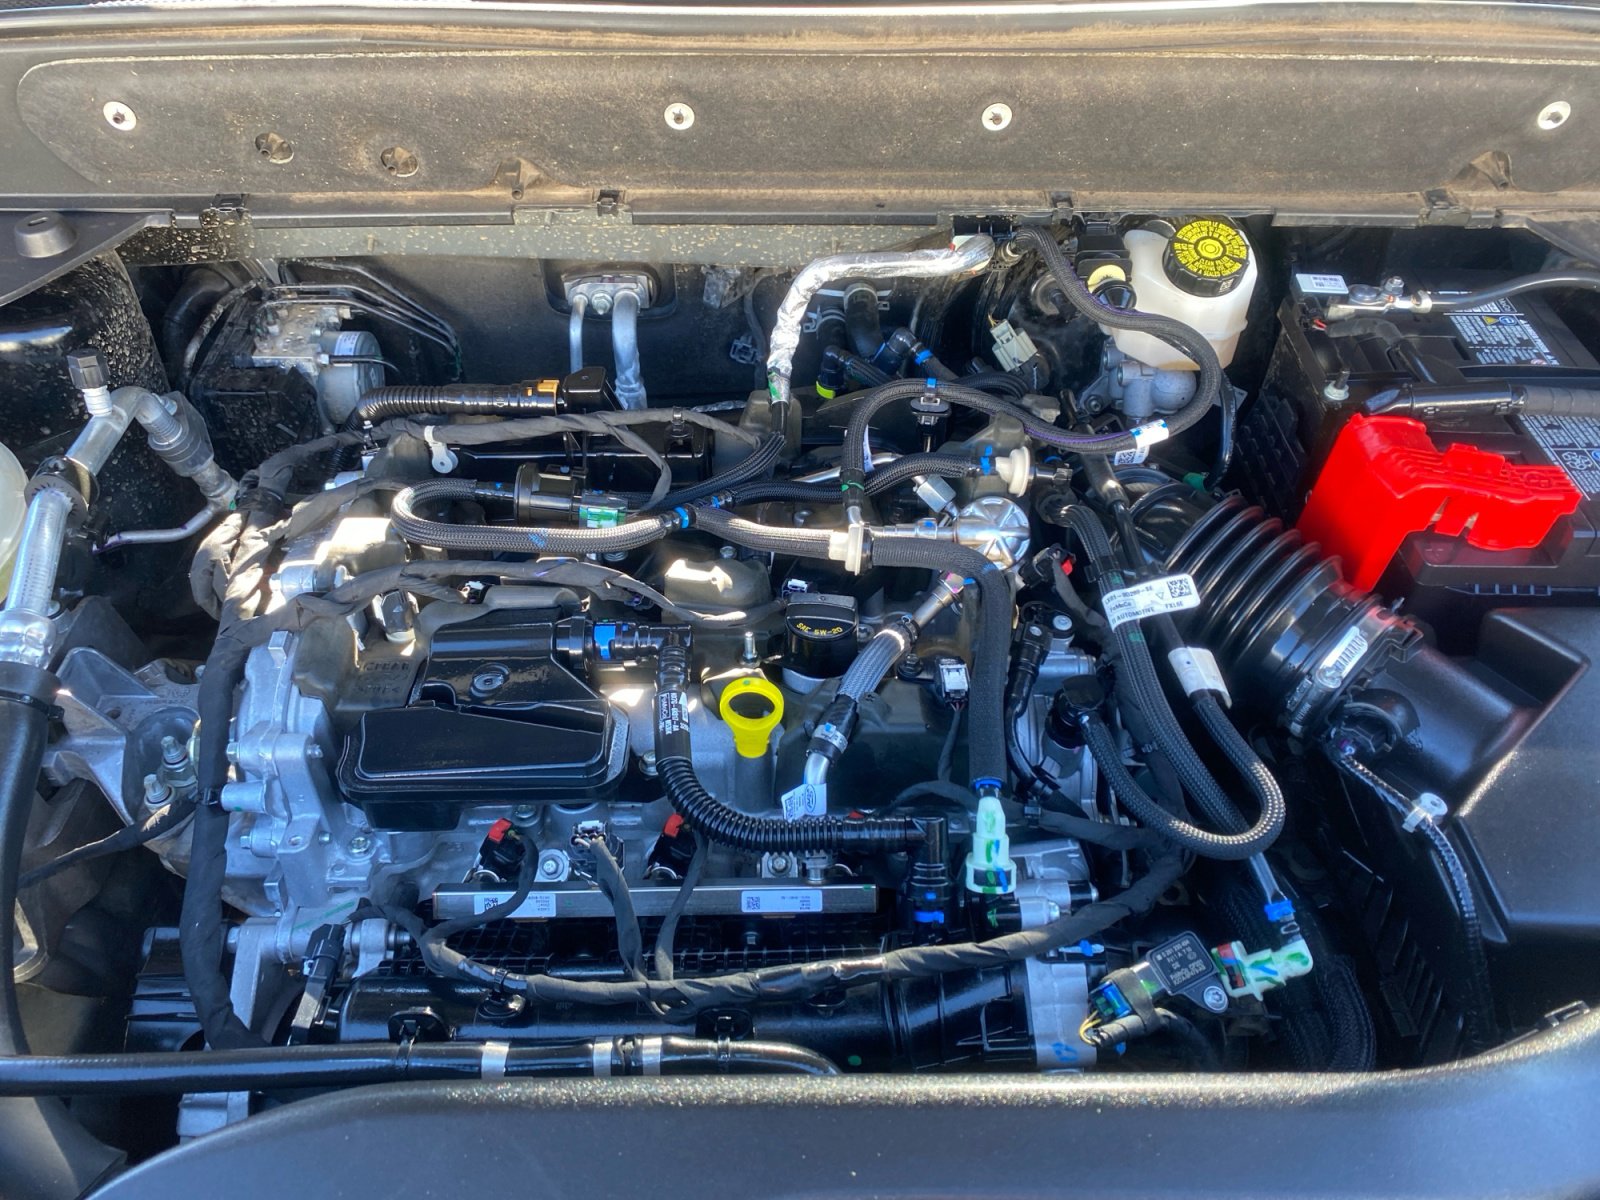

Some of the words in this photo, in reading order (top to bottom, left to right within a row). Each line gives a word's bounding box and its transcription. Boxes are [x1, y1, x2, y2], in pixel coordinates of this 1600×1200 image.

[1117, 606, 1155, 621] AUTOMOTIVE
[796, 622, 811, 633] SAE
[814, 626, 843, 636] 5W-20
